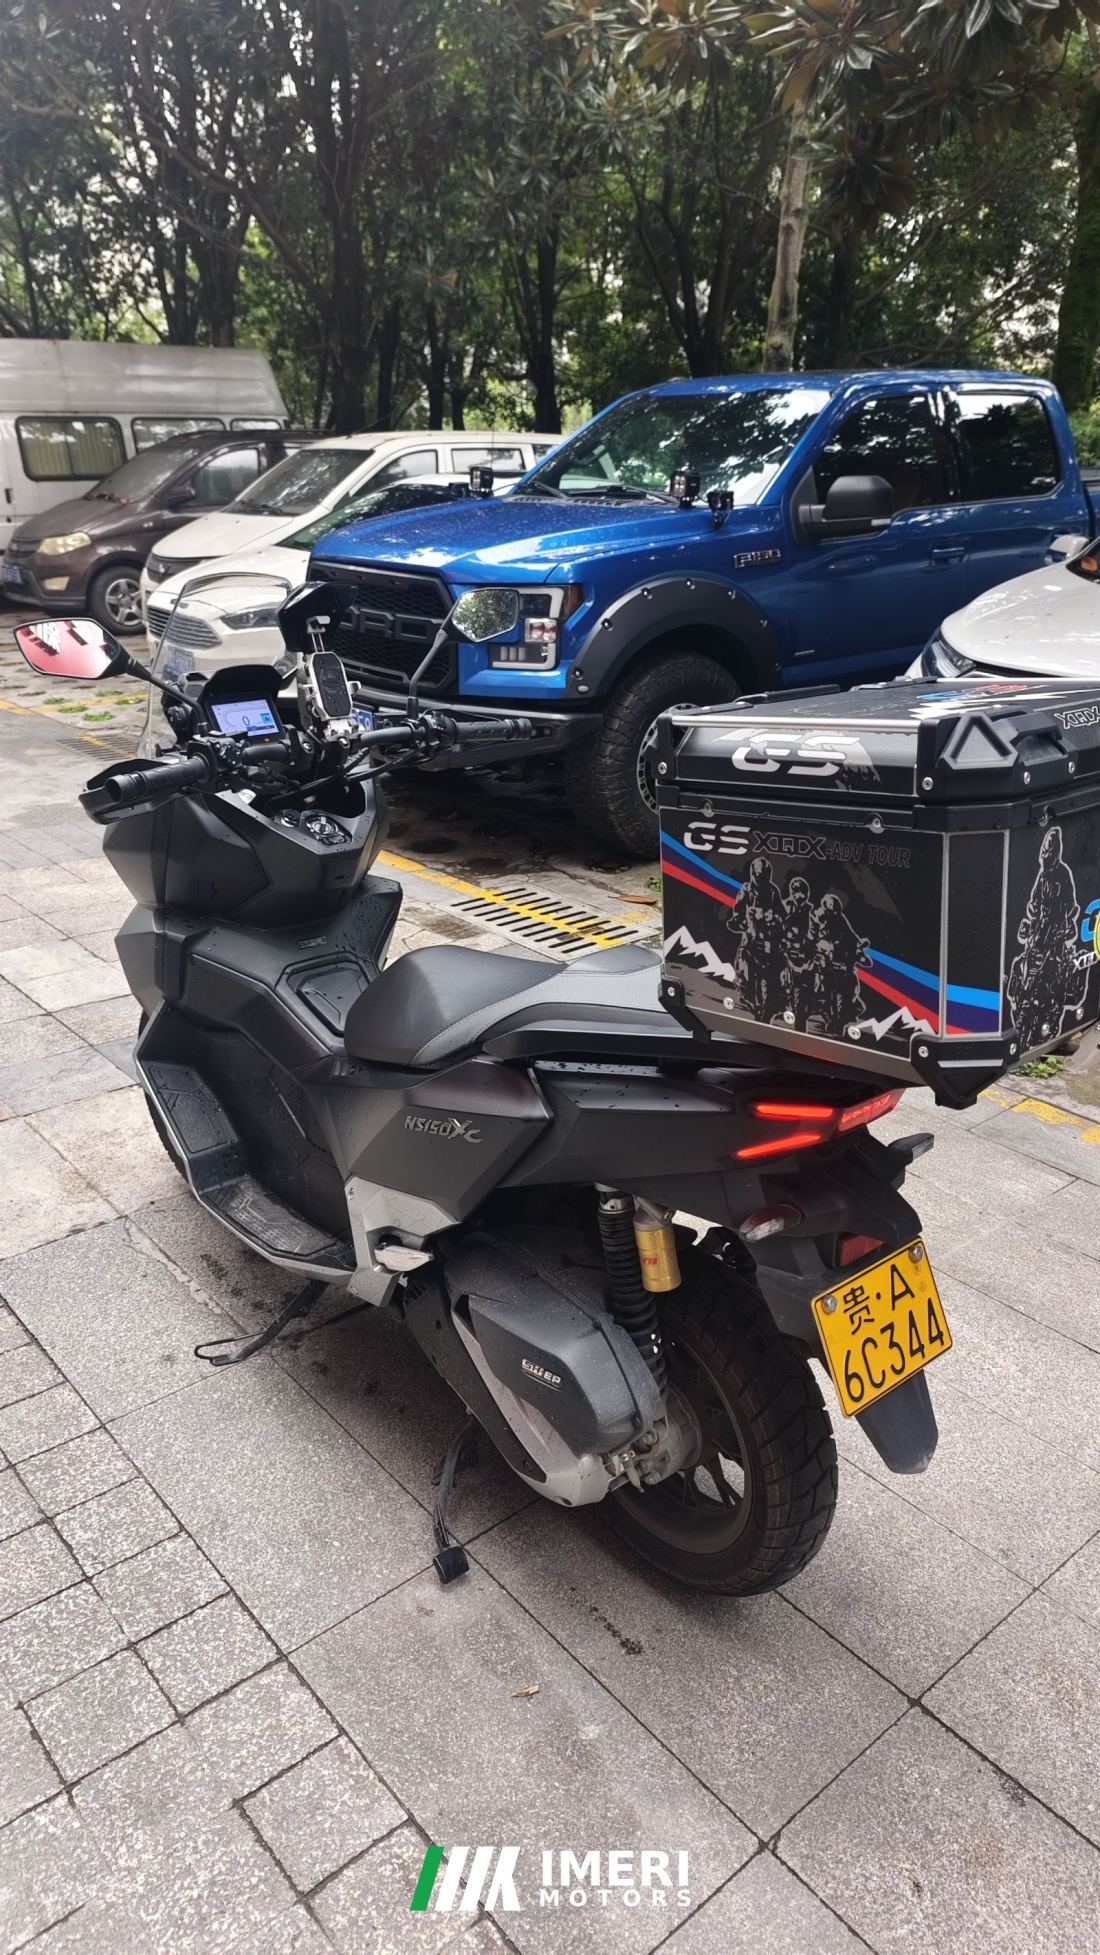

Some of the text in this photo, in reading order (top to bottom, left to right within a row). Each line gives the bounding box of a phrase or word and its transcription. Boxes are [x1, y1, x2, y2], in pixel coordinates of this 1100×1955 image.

[732, 734, 861, 777] GS
[684, 821, 750, 855] GS
[867, 843, 911, 868] TOUR
[844, 1298, 945, 1402] 6C344
